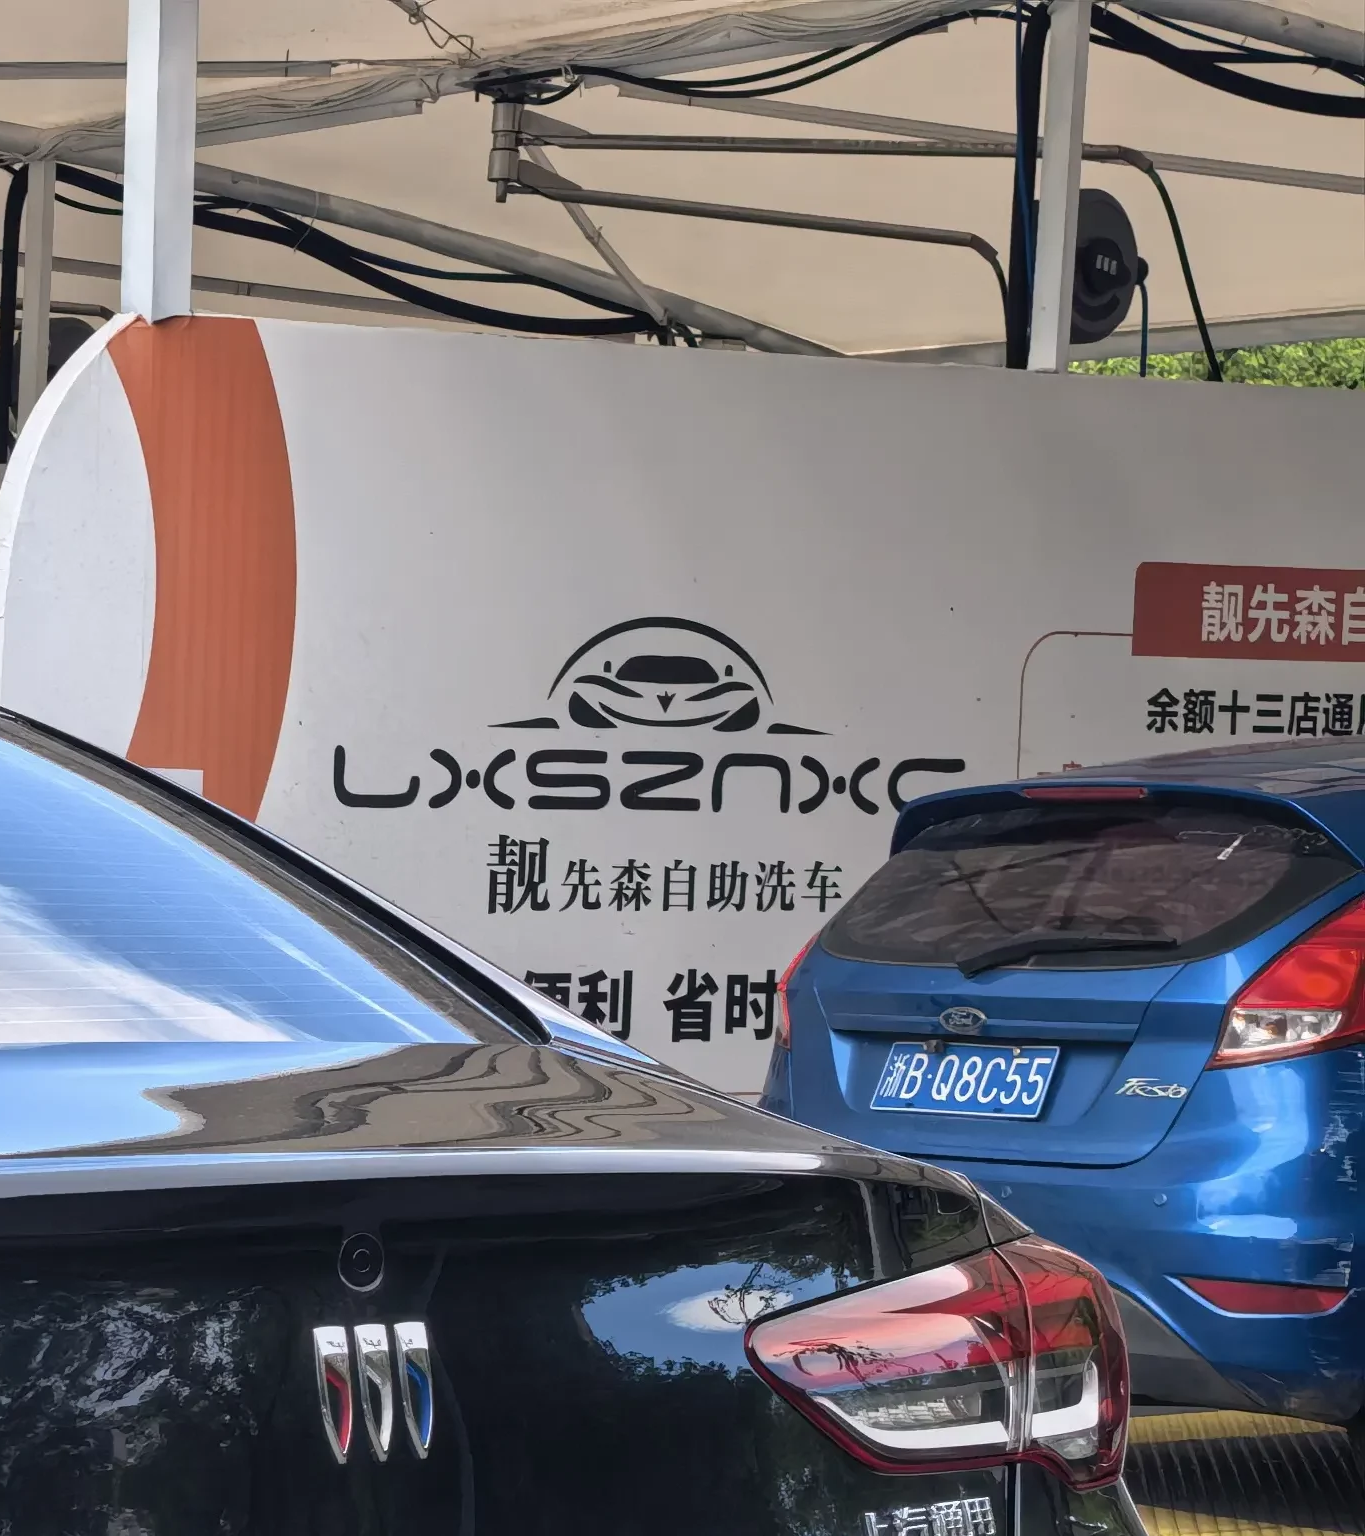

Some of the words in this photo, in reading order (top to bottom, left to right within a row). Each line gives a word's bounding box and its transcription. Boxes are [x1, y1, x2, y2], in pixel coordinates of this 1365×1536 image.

[1145, 687, 1365, 737] 余额十三店通
[486, 833, 843, 914] 靓先森自助洗车
[879, 1052, 1052, 1106] 浙B·Q8C55
